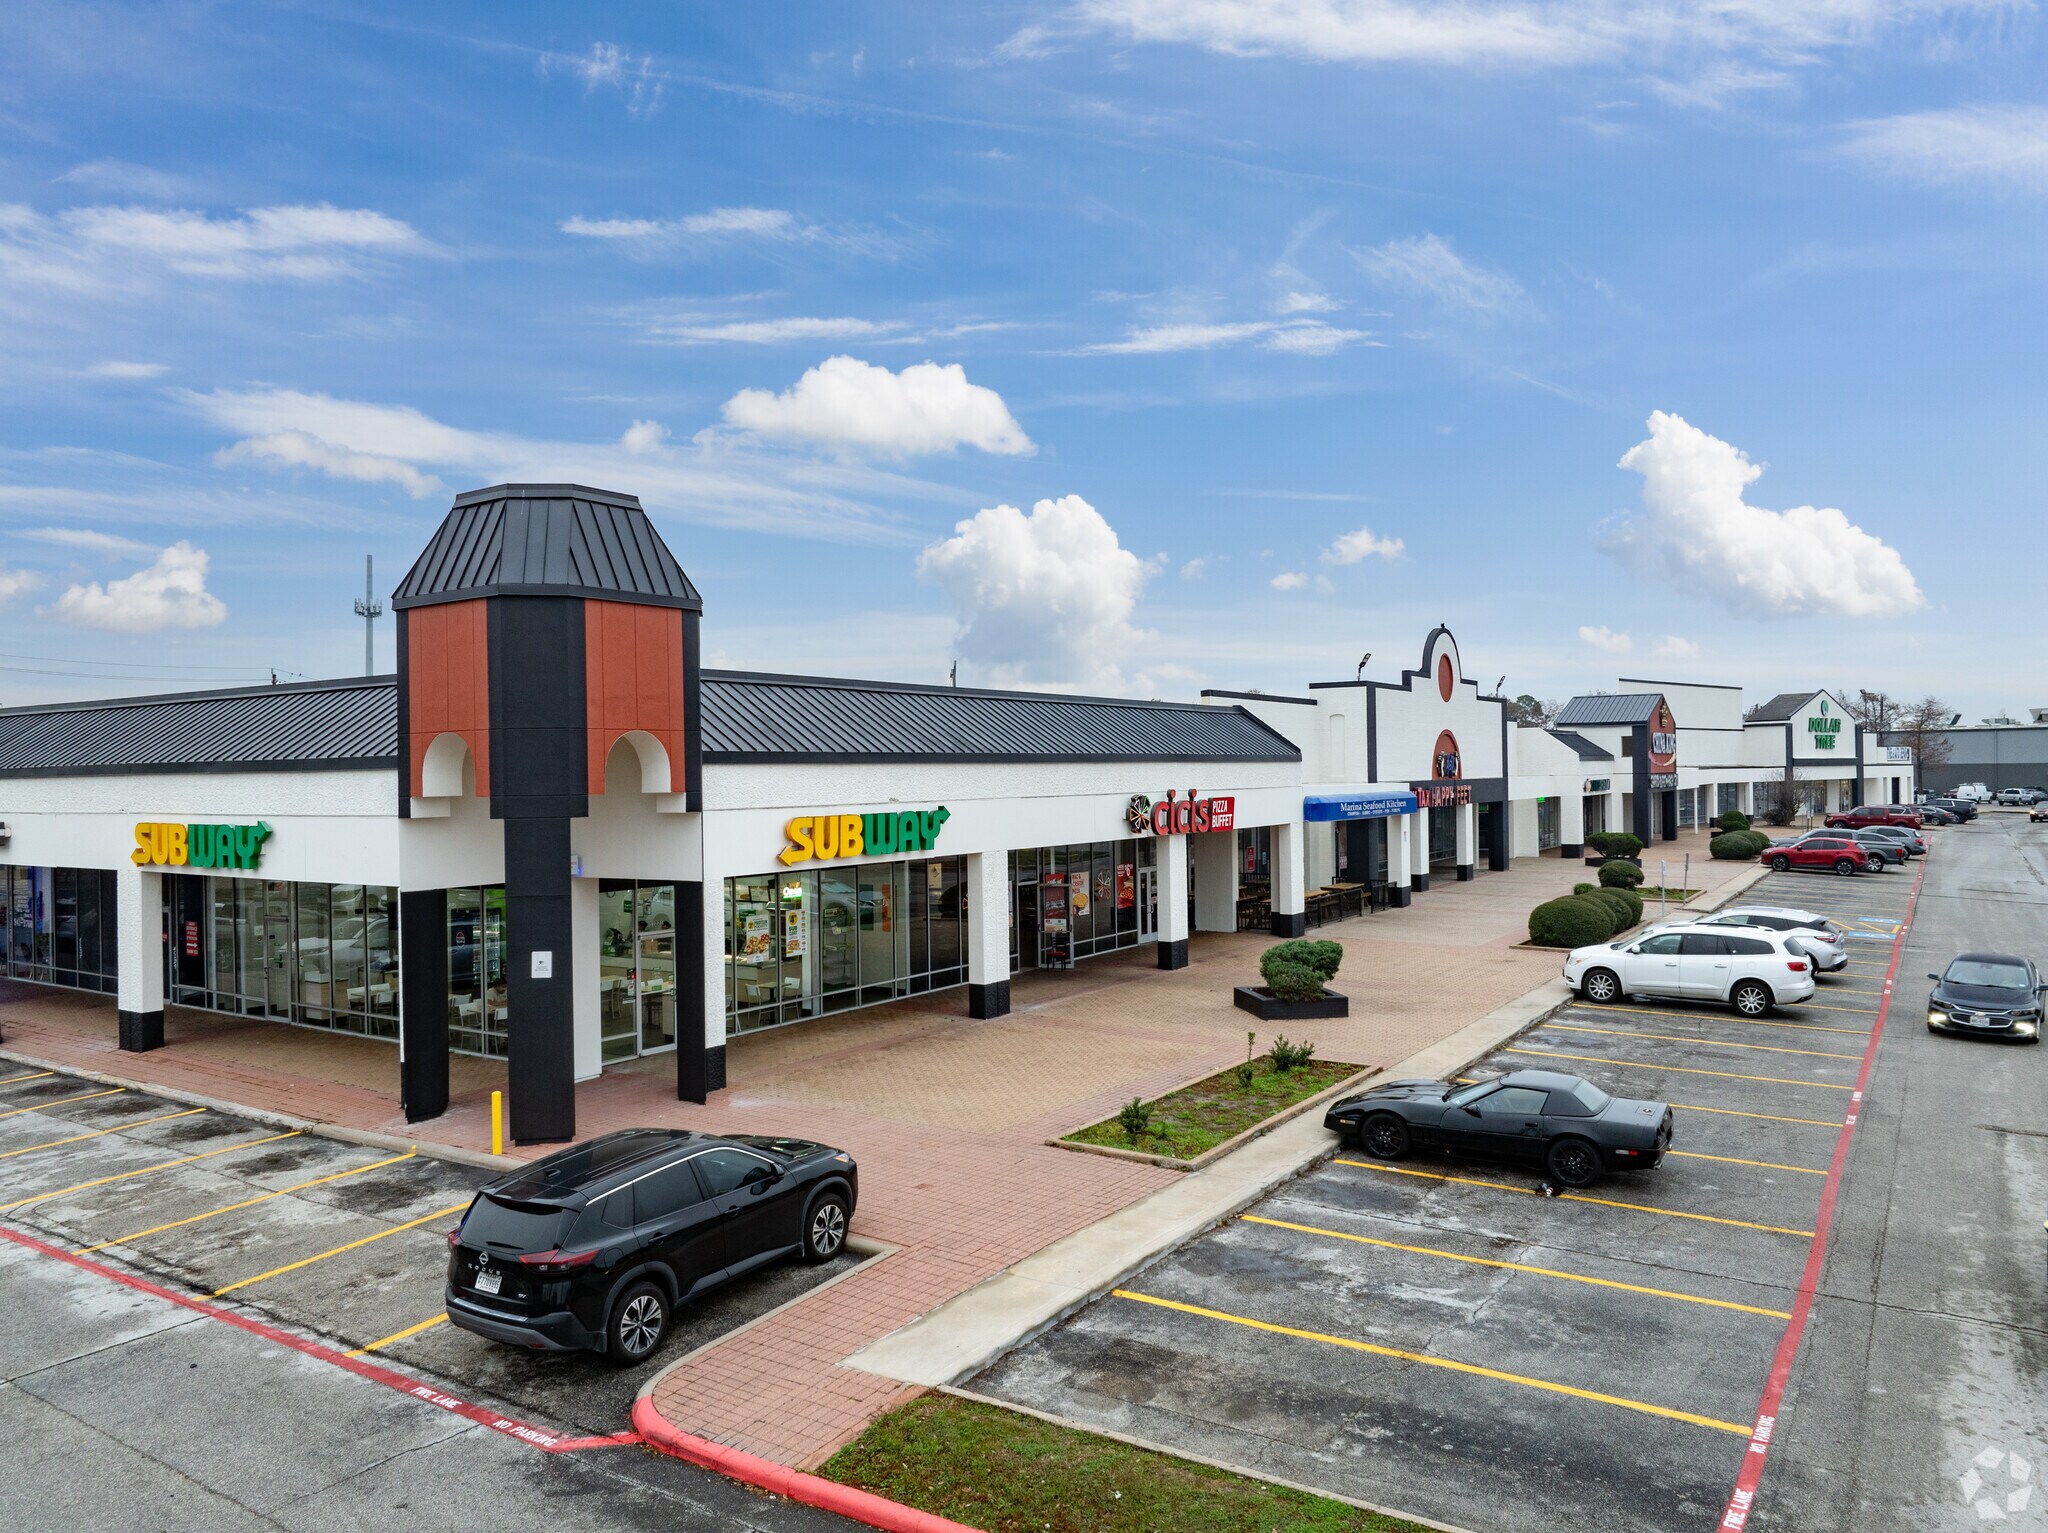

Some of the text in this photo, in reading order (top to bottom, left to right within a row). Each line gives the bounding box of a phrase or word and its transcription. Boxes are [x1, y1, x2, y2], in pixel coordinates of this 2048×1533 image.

[1808, 717, 1841, 733] DOLLAR
[1814, 735, 1835, 749] TREE
[1212, 800, 1228, 813] PIZZA
[1340, 802, 1362, 812] Marina
[1363, 801, 1386, 811] Seafood
[1386, 799, 1407, 808] Kitchen
[1418, 785, 1472, 807] TAX HAPPY FEET
[1150, 788, 1210, 835] cicis
[1212, 814, 1233, 828] BUFFET
[131, 821, 272, 869] SUBWAY
[776, 806, 951, 867] SUBWAY
[410, 1387, 462, 1408] FIRE LANE
[493, 1419, 557, 1446] NO PARKING
[1749, 1415, 1775, 1454] NO PARKING
[1723, 1488, 1753, 1530] FIRE LANE
